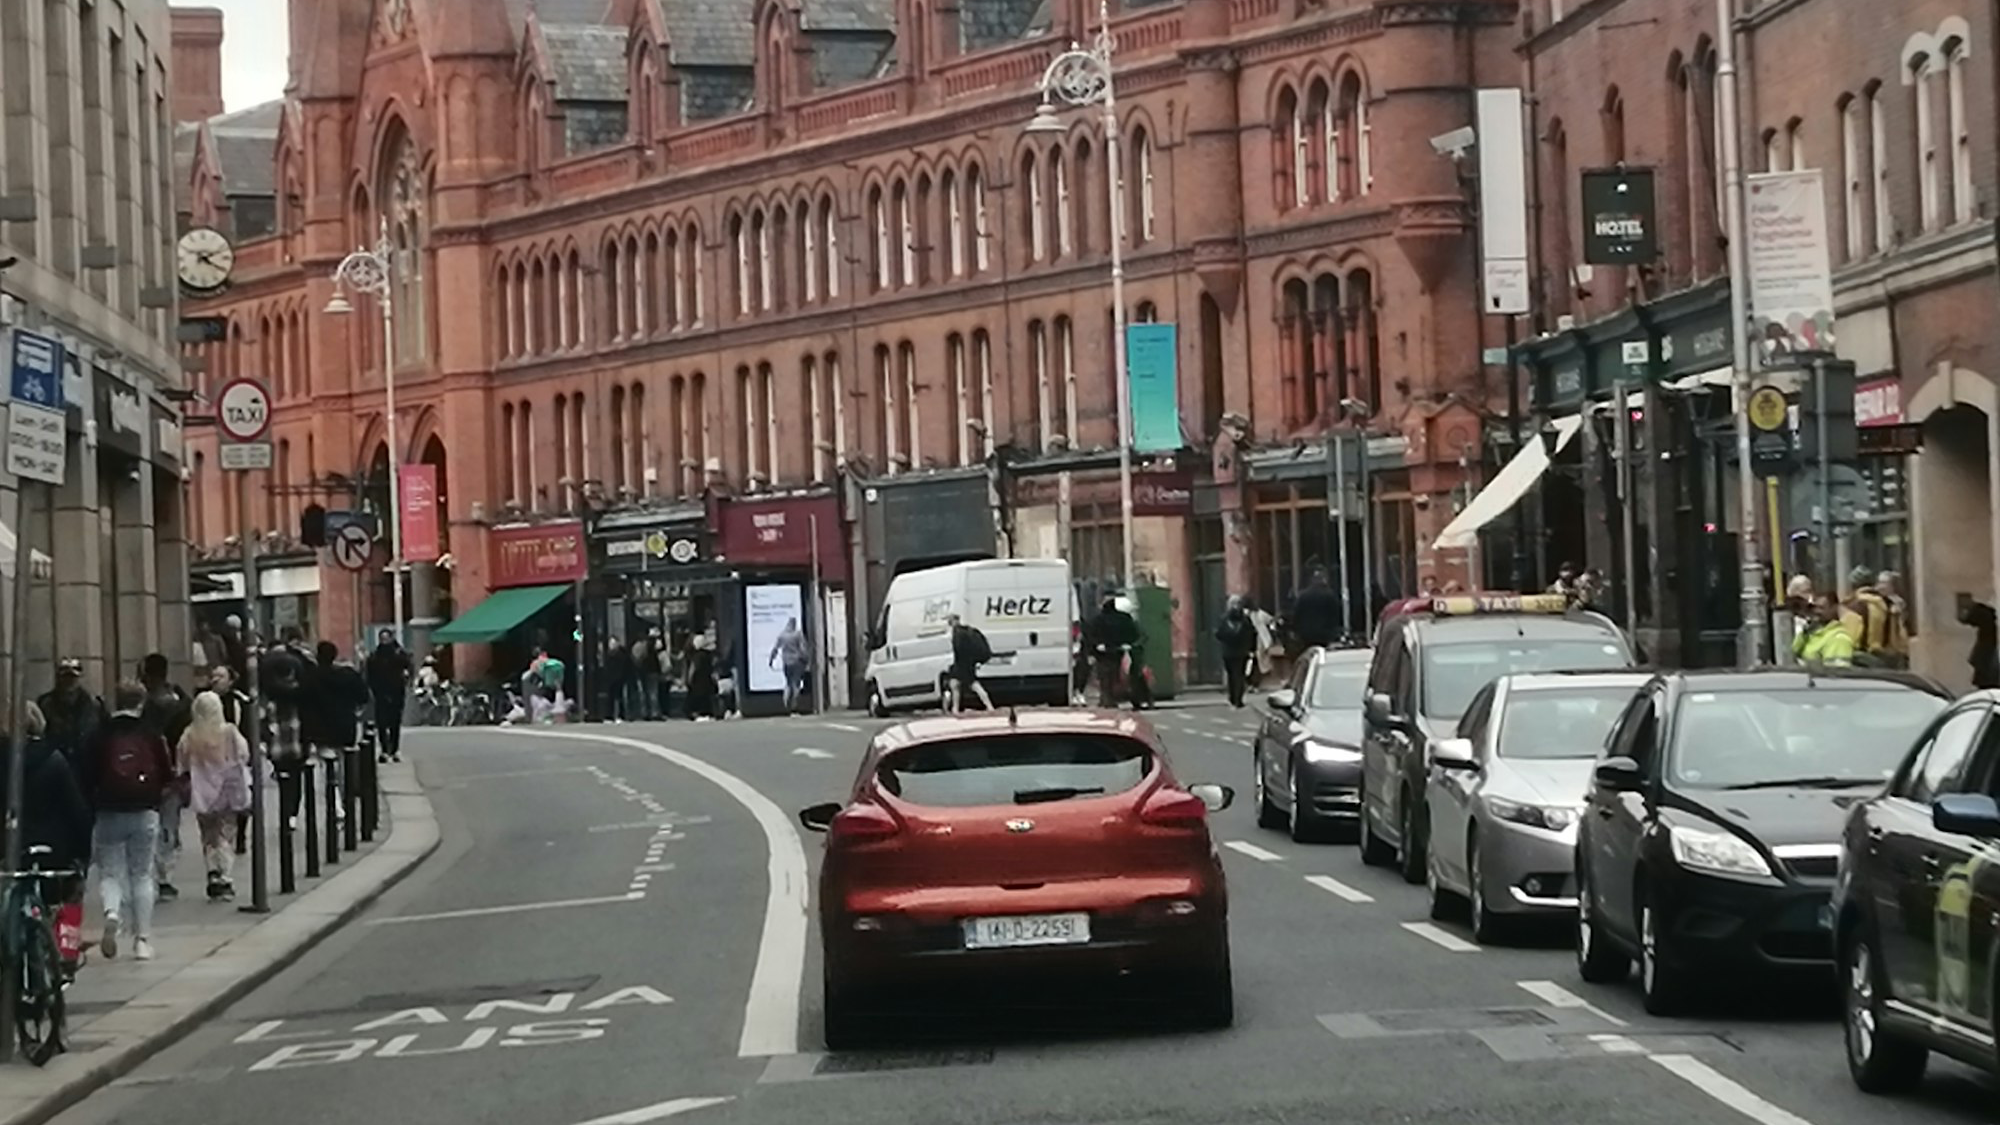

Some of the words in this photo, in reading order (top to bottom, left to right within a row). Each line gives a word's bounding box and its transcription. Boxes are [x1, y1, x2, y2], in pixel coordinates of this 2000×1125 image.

[1595, 220, 1644, 237] HOTEL
[226, 407, 265, 424] TAXI
[985, 594, 1052, 617] Hertz
[1480, 596, 1521, 611] TAXI
[233, 985, 675, 1043] LANA
[248, 1018, 611, 1071] BUS
